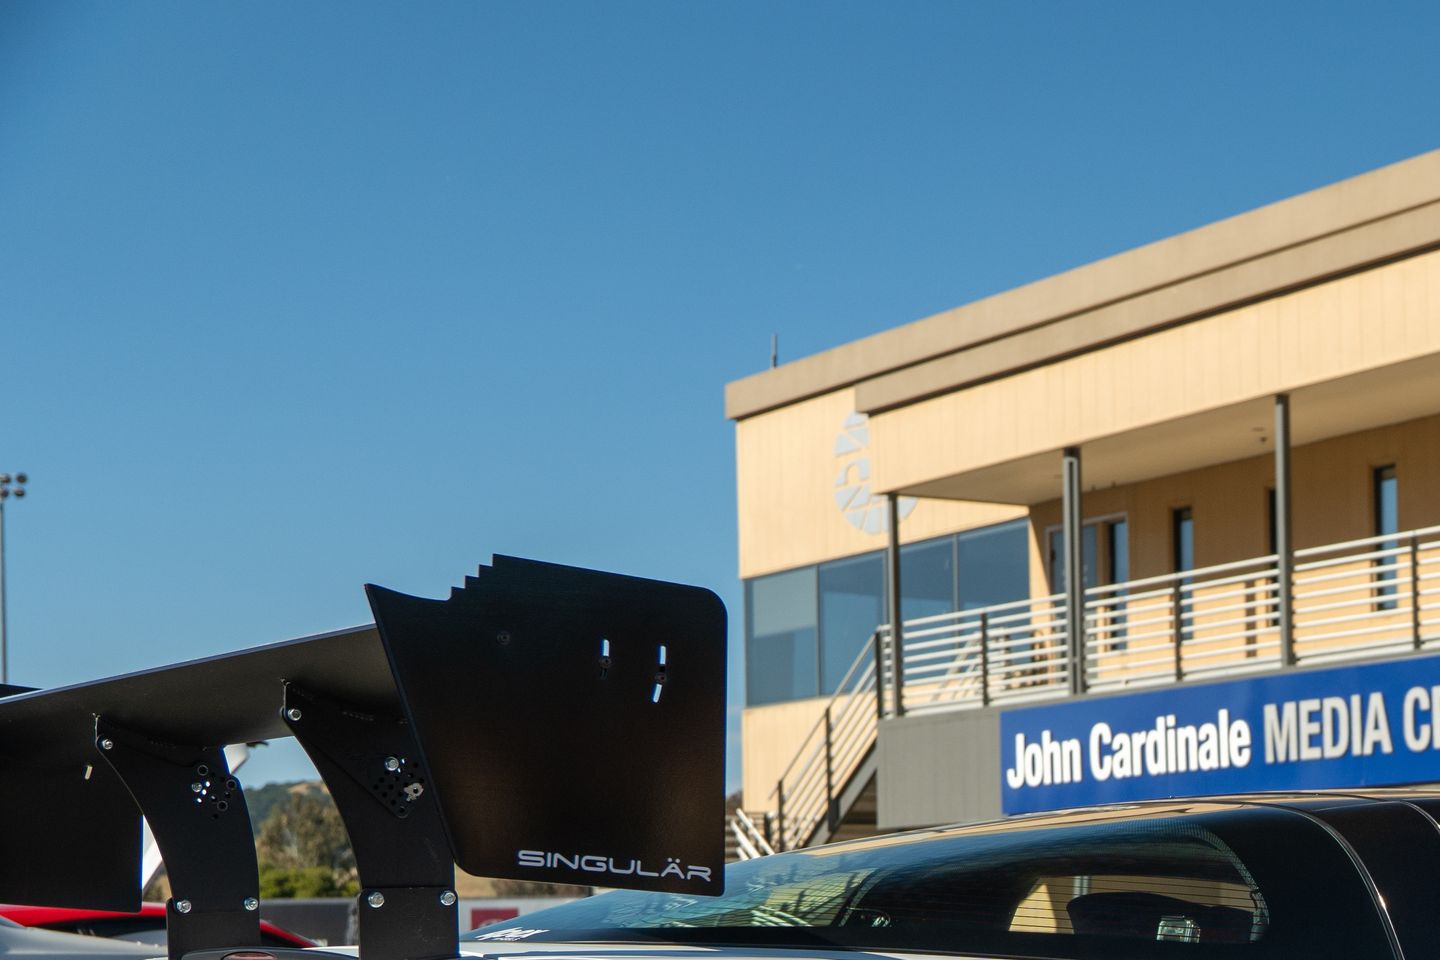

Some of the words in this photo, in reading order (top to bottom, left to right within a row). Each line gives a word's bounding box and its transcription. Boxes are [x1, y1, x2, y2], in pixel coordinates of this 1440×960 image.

[1006, 730, 1082, 789] John
[1089, 708, 1251, 781] Cardinale
[1264, 692, 1393, 764] MEDIA
[518, 850, 712, 882] SINGULÄR
